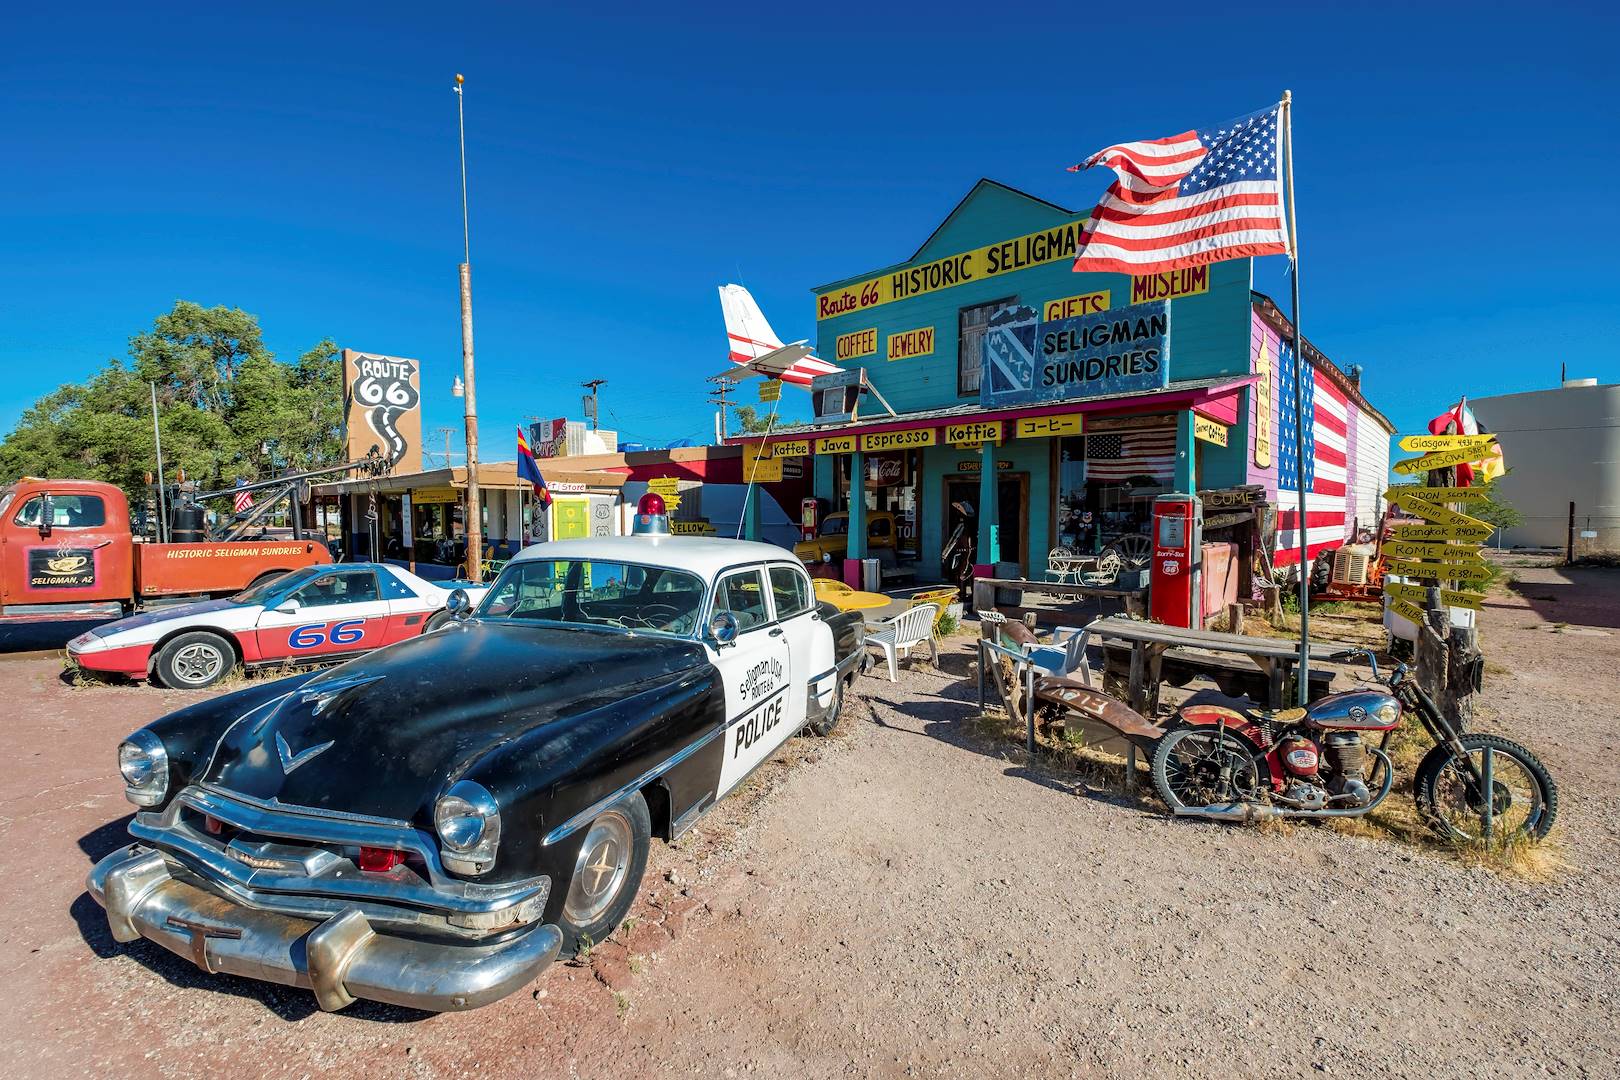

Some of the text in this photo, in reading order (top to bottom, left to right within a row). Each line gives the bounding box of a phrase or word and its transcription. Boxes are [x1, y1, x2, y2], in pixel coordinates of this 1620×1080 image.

[820, 291, 857, 317] Route
[861, 281, 879, 307] 66
[893, 255, 972, 299] HISTORIC
[1133, 264, 1207, 303] MUSEUM
[838, 330, 875, 358] COFFEE
[889, 329, 933, 358] JEWELRY
[1043, 313, 1168, 355] SELIGMAN
[991, 332, 1031, 383] MALTS
[1042, 349, 1159, 386] SUNDRIES
[362, 360, 409, 381] ROUTE
[360, 377, 410, 405] 66
[949, 424, 997, 442] Koffie
[1024, 419, 1073, 433] コーヒー
[1209, 425, 1226, 444] Coffee
[774, 443, 807, 456] Kaffee
[822, 439, 851, 452] Java
[866, 431, 929, 449] Espresso
[1404, 452, 1465, 473] Warsaw
[1408, 500, 1441, 518] Berlin
[1401, 526, 1449, 538] Bangkok
[167, 546, 303, 558] HISTORIC SELIGMAN SUNDRIES
[1396, 545, 1436, 557] ROME
[1400, 586, 1427, 598] Pari
[288, 618, 366, 650] 66
[739, 656, 783, 701] Seligman USA
[734, 696, 783, 759] POLICE
